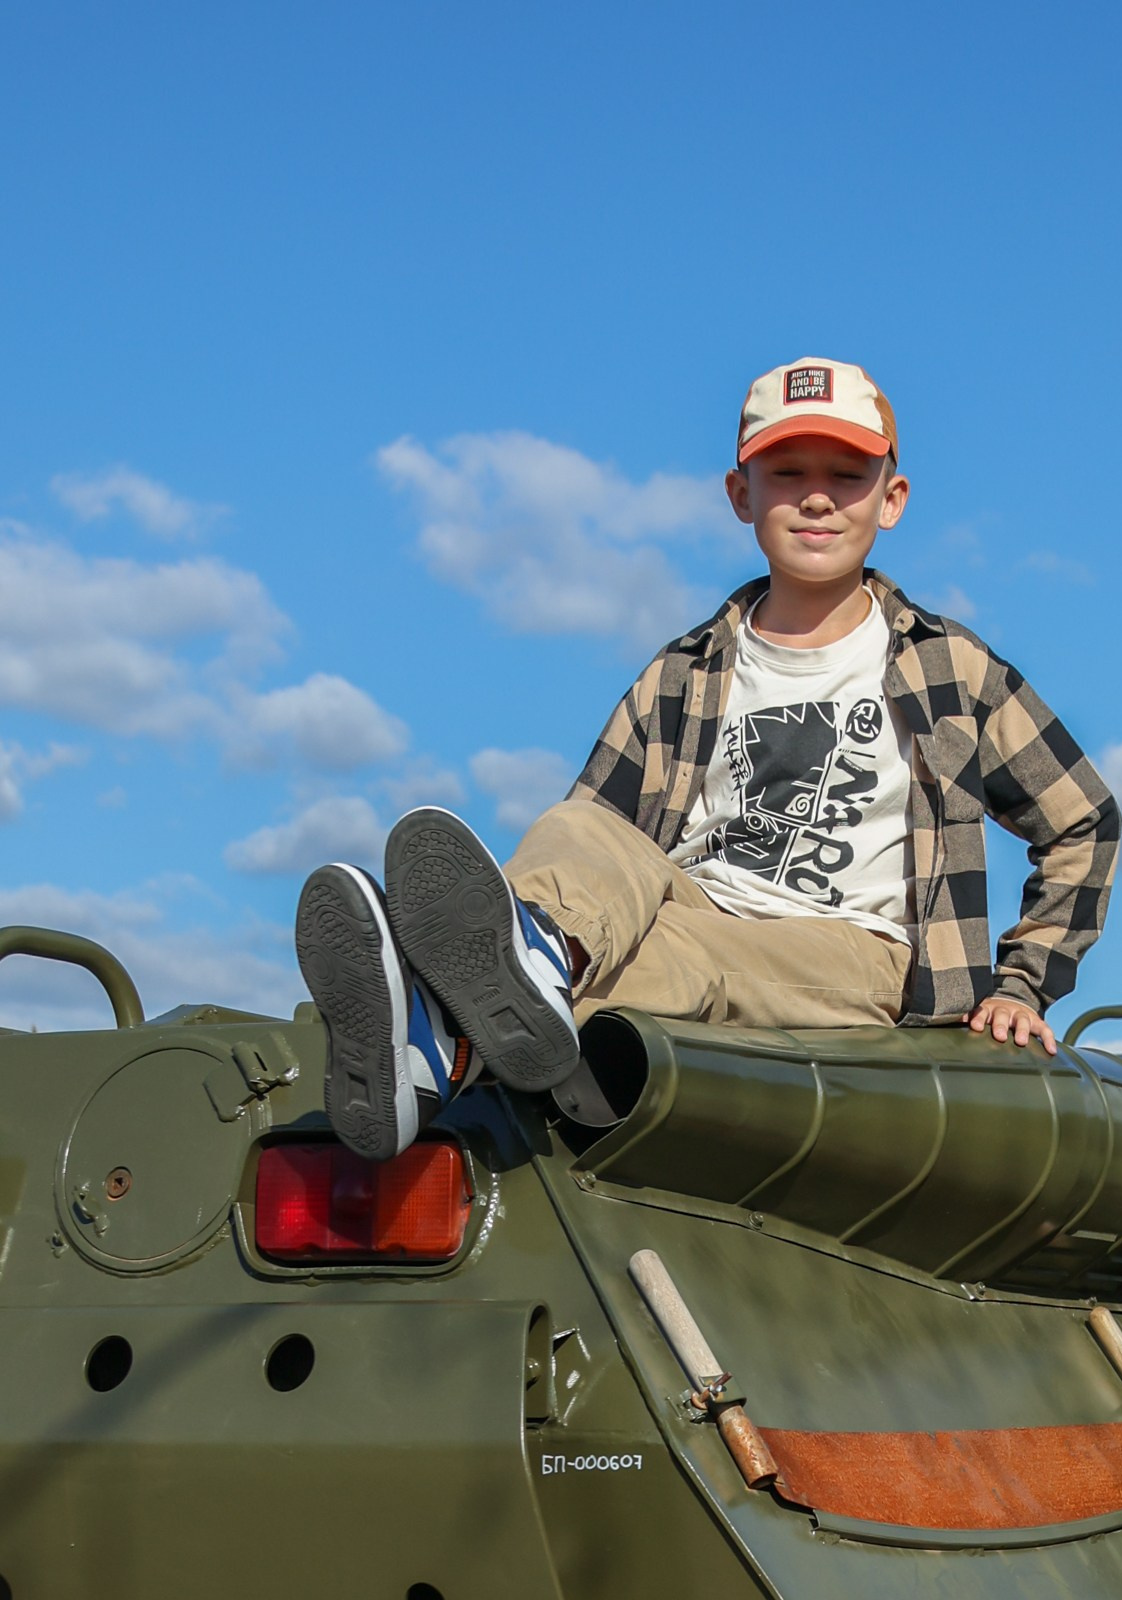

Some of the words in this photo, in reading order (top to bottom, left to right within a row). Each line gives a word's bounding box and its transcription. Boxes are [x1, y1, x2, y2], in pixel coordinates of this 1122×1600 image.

[790, 370, 808, 380] JUST
[808, 370, 825, 378] HIKE
[790, 377, 809, 388] AND
[813, 376, 825, 386] BE
[790, 386, 825, 399] HAPPY
[542, 1455, 642, 1475] БП-000607
